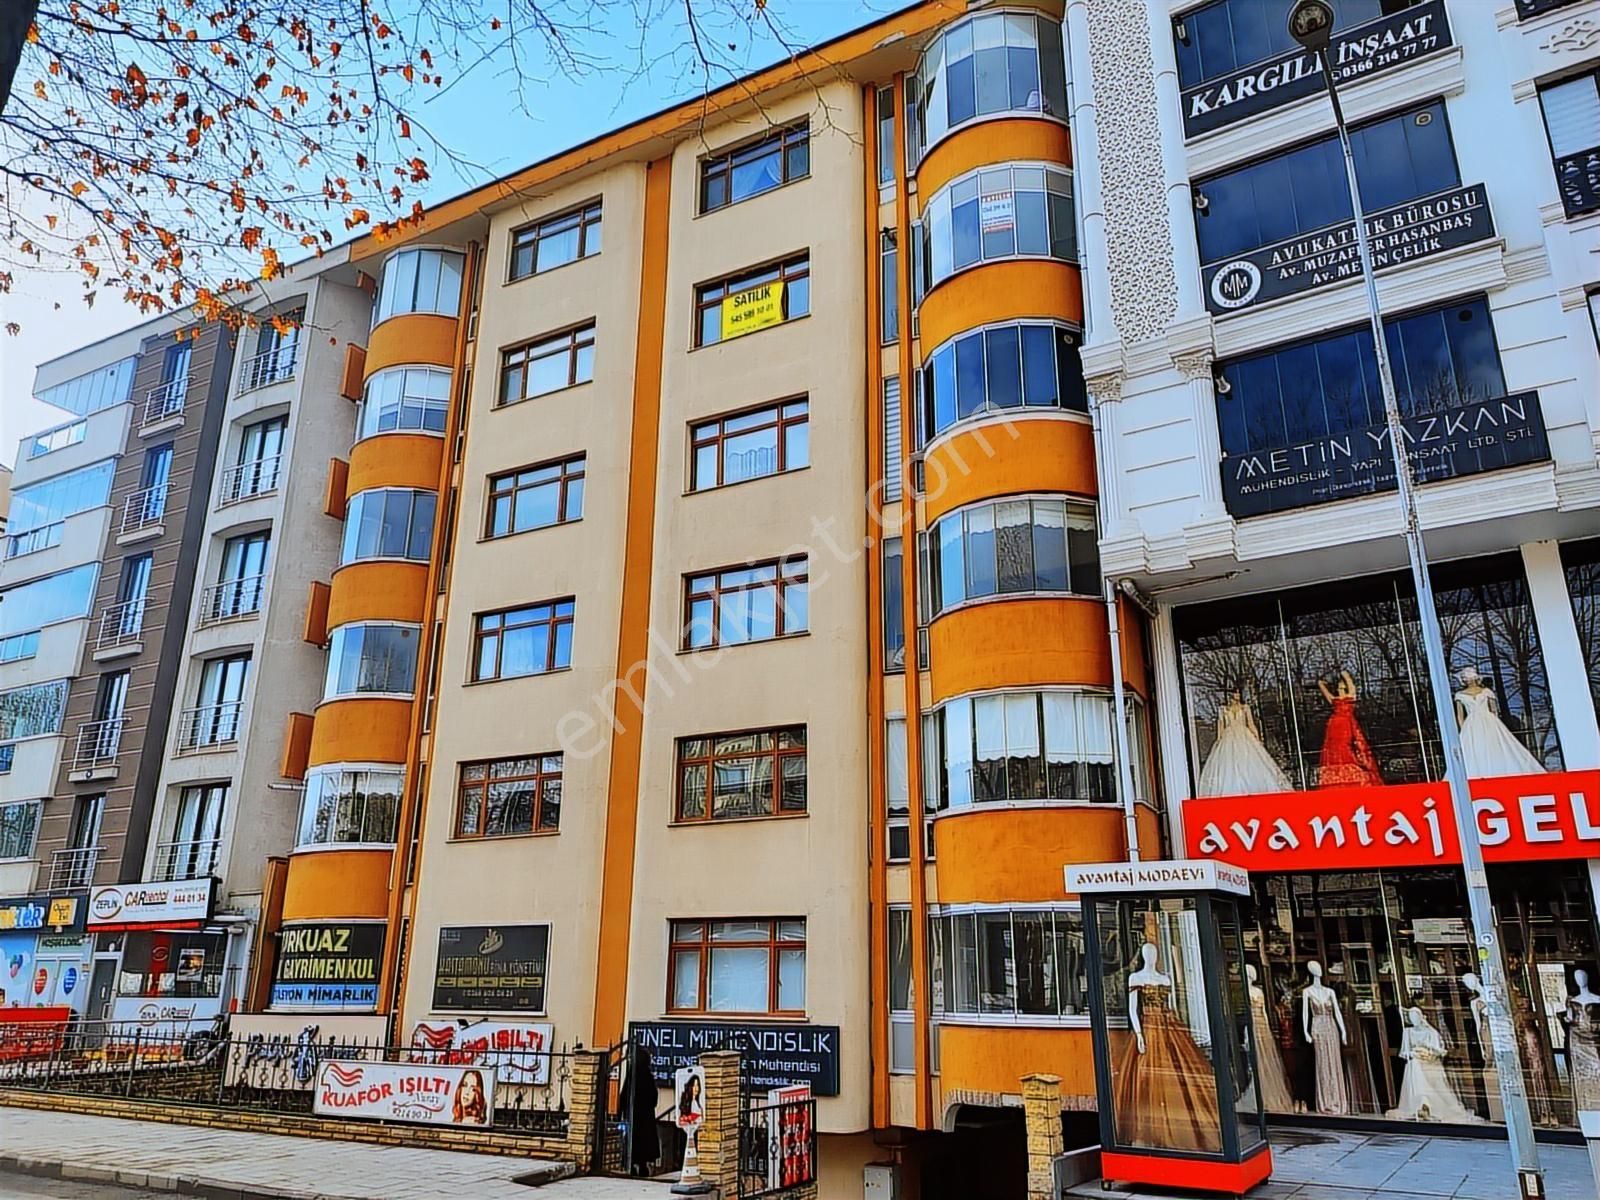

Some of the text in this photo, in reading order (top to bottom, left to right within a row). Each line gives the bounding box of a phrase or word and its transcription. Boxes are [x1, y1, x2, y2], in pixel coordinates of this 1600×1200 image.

[1336, 14, 1432, 65] İNŞAAT
[1342, 35, 1437, 77] 0366 214 77 77
[1392, 191, 1477, 229] BÜROSU
[1389, 213, 1473, 246] HASANBAŞ
[1337, 253, 1388, 277] MEİN
[734, 287, 771, 308] SATILIK
[1351, 458, 1382, 472] YAPI
[1468, 434, 1499, 449] LTD.
[1200, 797, 1444, 858] avantaj
[1076, 868, 1133, 886] avantaj
[322, 1076, 451, 1107] KUAFÖR IŞILTI
